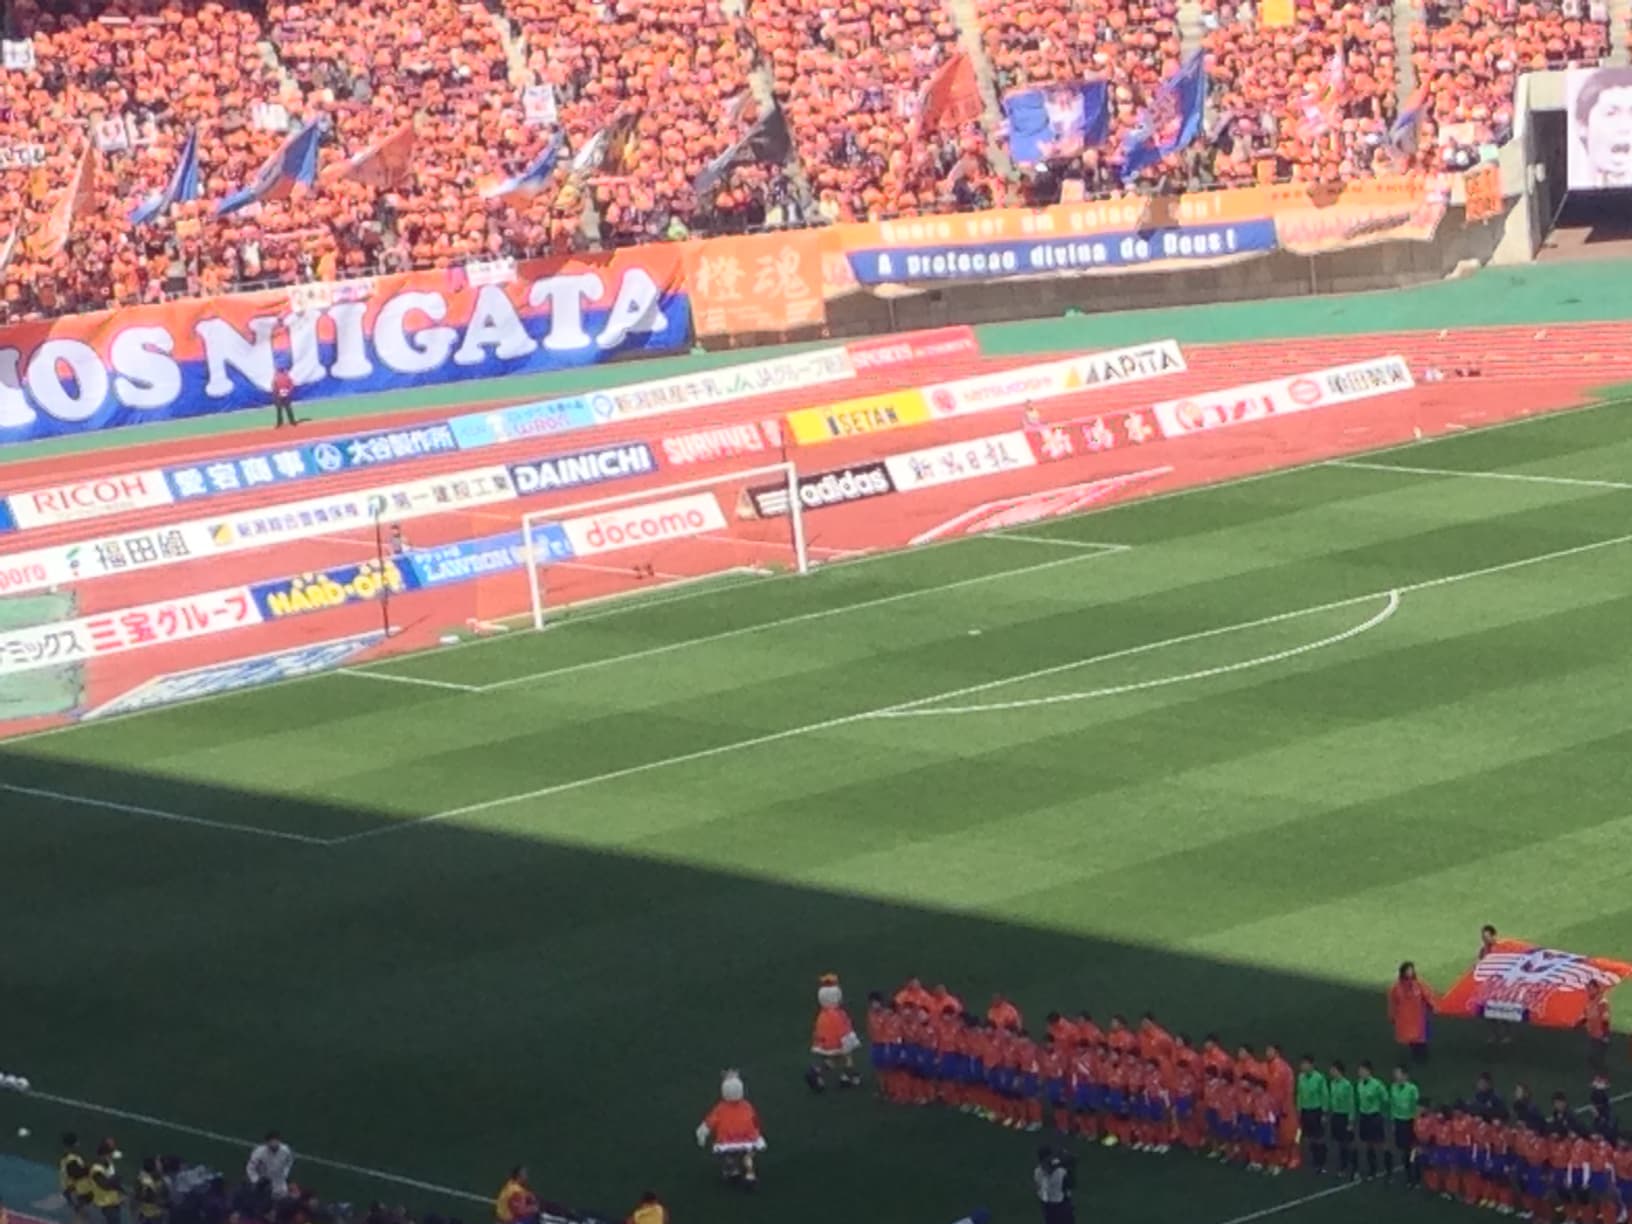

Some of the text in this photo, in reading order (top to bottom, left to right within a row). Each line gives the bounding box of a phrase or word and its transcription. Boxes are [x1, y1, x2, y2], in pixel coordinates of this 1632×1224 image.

[196, 267, 668, 398] NIIGATA
[827, 407, 900, 436] ISETAN
[513, 444, 651, 492] DAINICHI
[799, 467, 890, 508] adidas
[32, 475, 148, 514] RICOH
[586, 506, 705, 548] docomo
[87, 594, 249, 651] 三宝グループ
